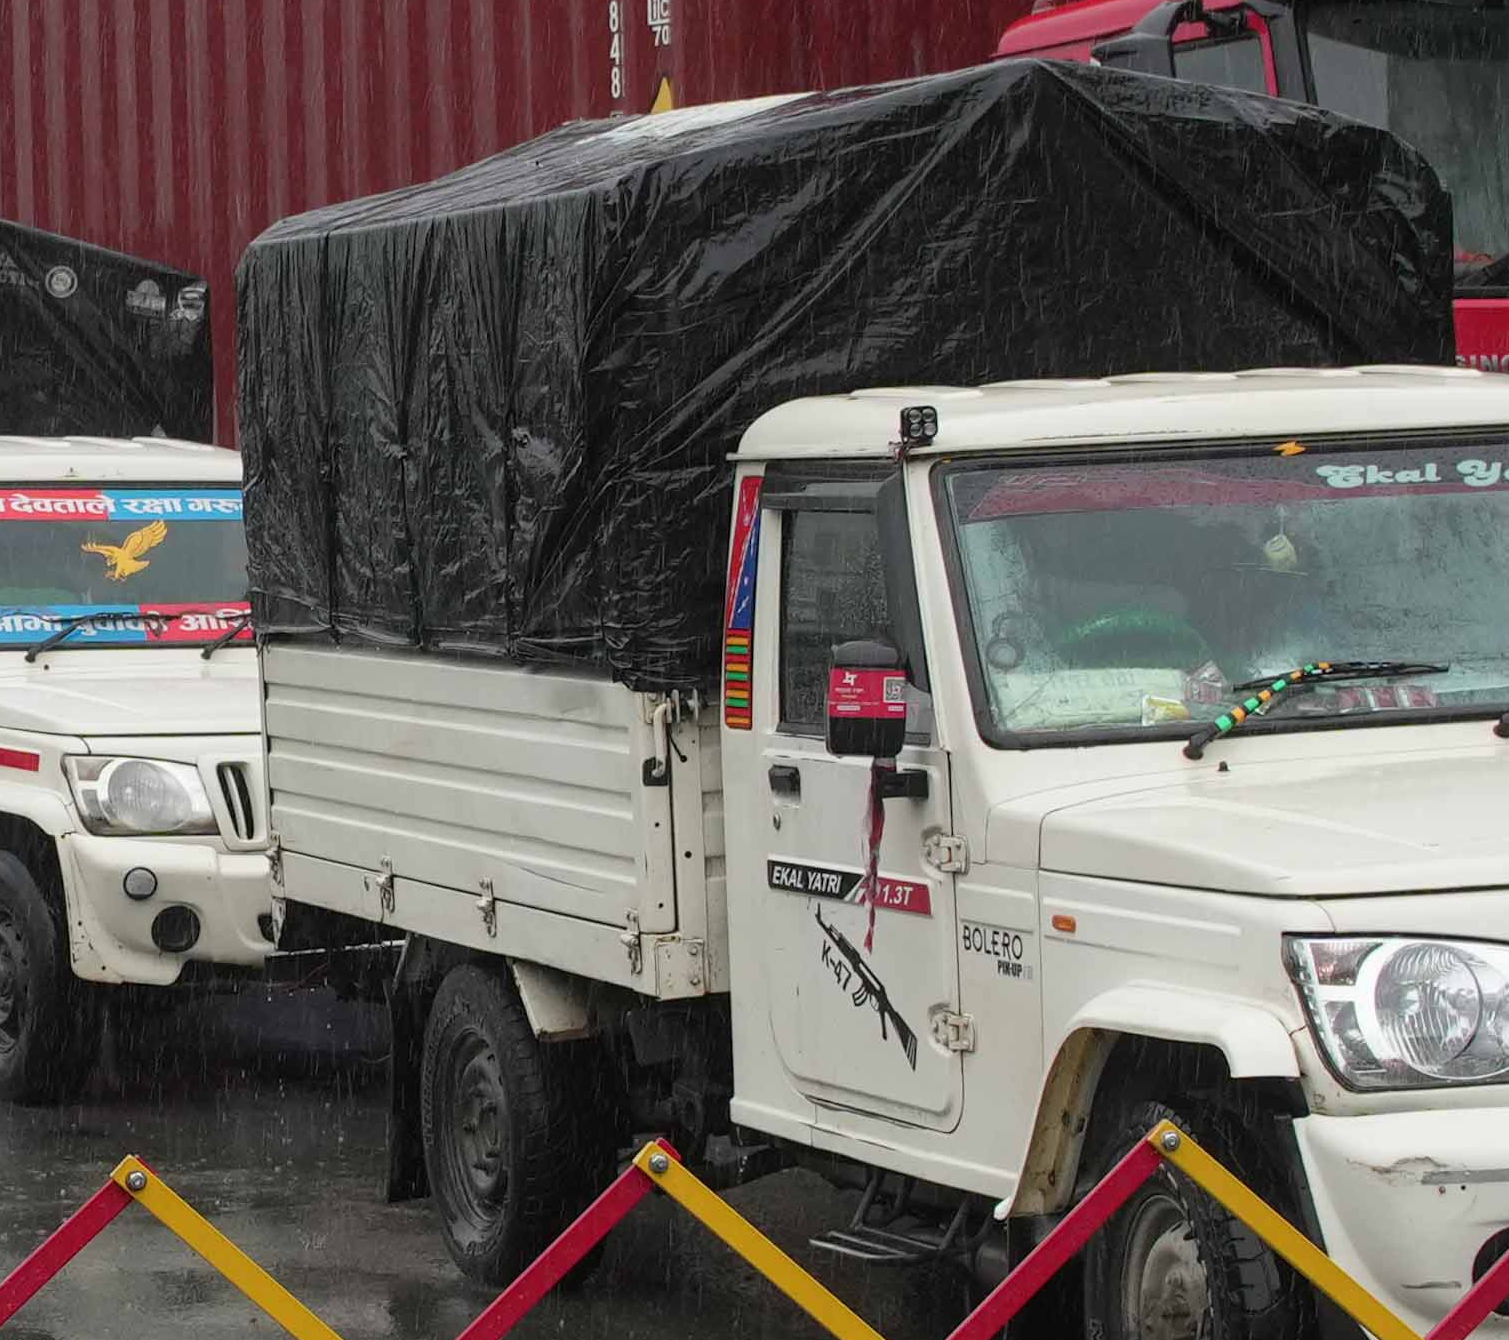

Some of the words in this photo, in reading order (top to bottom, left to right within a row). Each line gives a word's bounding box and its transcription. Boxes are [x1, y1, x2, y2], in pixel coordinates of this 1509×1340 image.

[651, 25, 671, 47] 70
[9, 494, 116, 515] देवताले
[121, 495, 183, 515] रक्षा
[772, 865, 804, 888] EKAL
[806, 870, 842, 895] YATRI
[882, 883, 914, 907] 1.3T
[962, 924, 1024, 961] BOLERO
